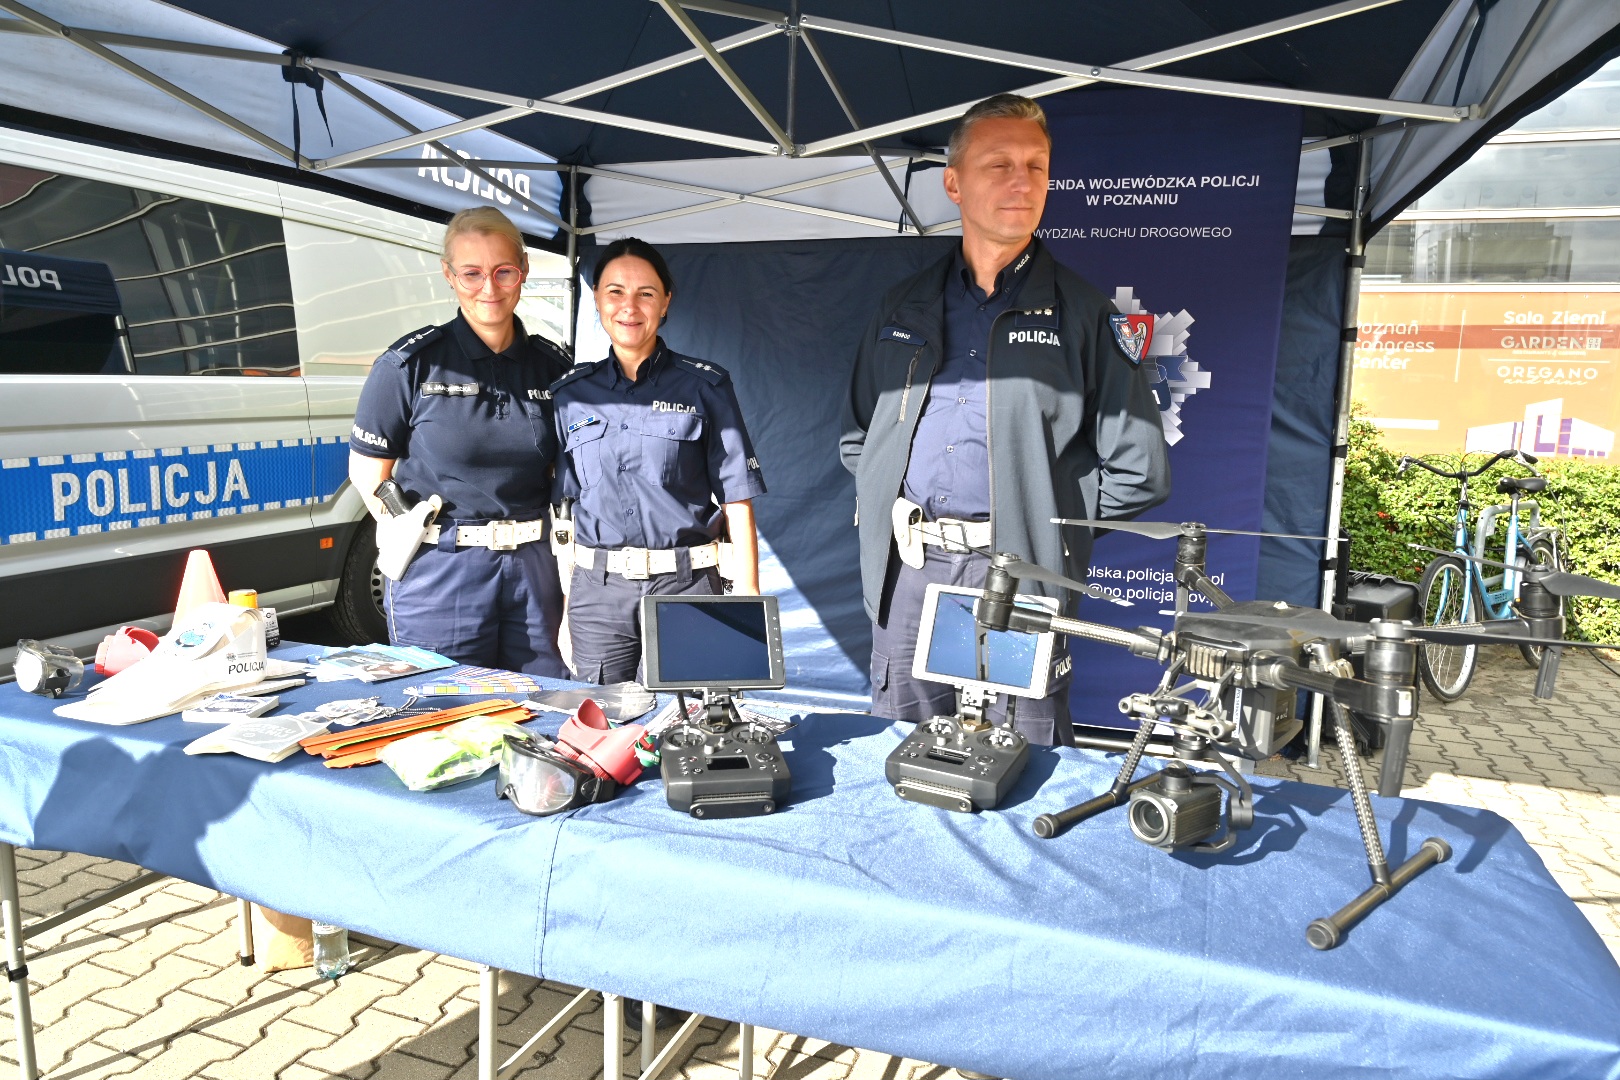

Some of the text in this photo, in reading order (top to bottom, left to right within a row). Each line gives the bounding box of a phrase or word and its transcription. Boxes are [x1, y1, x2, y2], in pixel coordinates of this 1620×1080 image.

[1089, 175, 1197, 190] WOJEWÓDZKA
[1200, 175, 1260, 188] POLICJI
[1086, 193, 1179, 206] W POZNANIU
[1090, 227, 1137, 238] RUCHU
[1140, 226, 1232, 238] DROGOWEGO
[1503, 310, 1607, 325] Sala Ziemi
[1008, 330, 1061, 347] POLICJA
[1500, 336, 1584, 350] GARDEN
[1496, 366, 1599, 380] OREGANO
[652, 400, 697, 414] POLICJA
[51, 458, 251, 522] POLICJA
